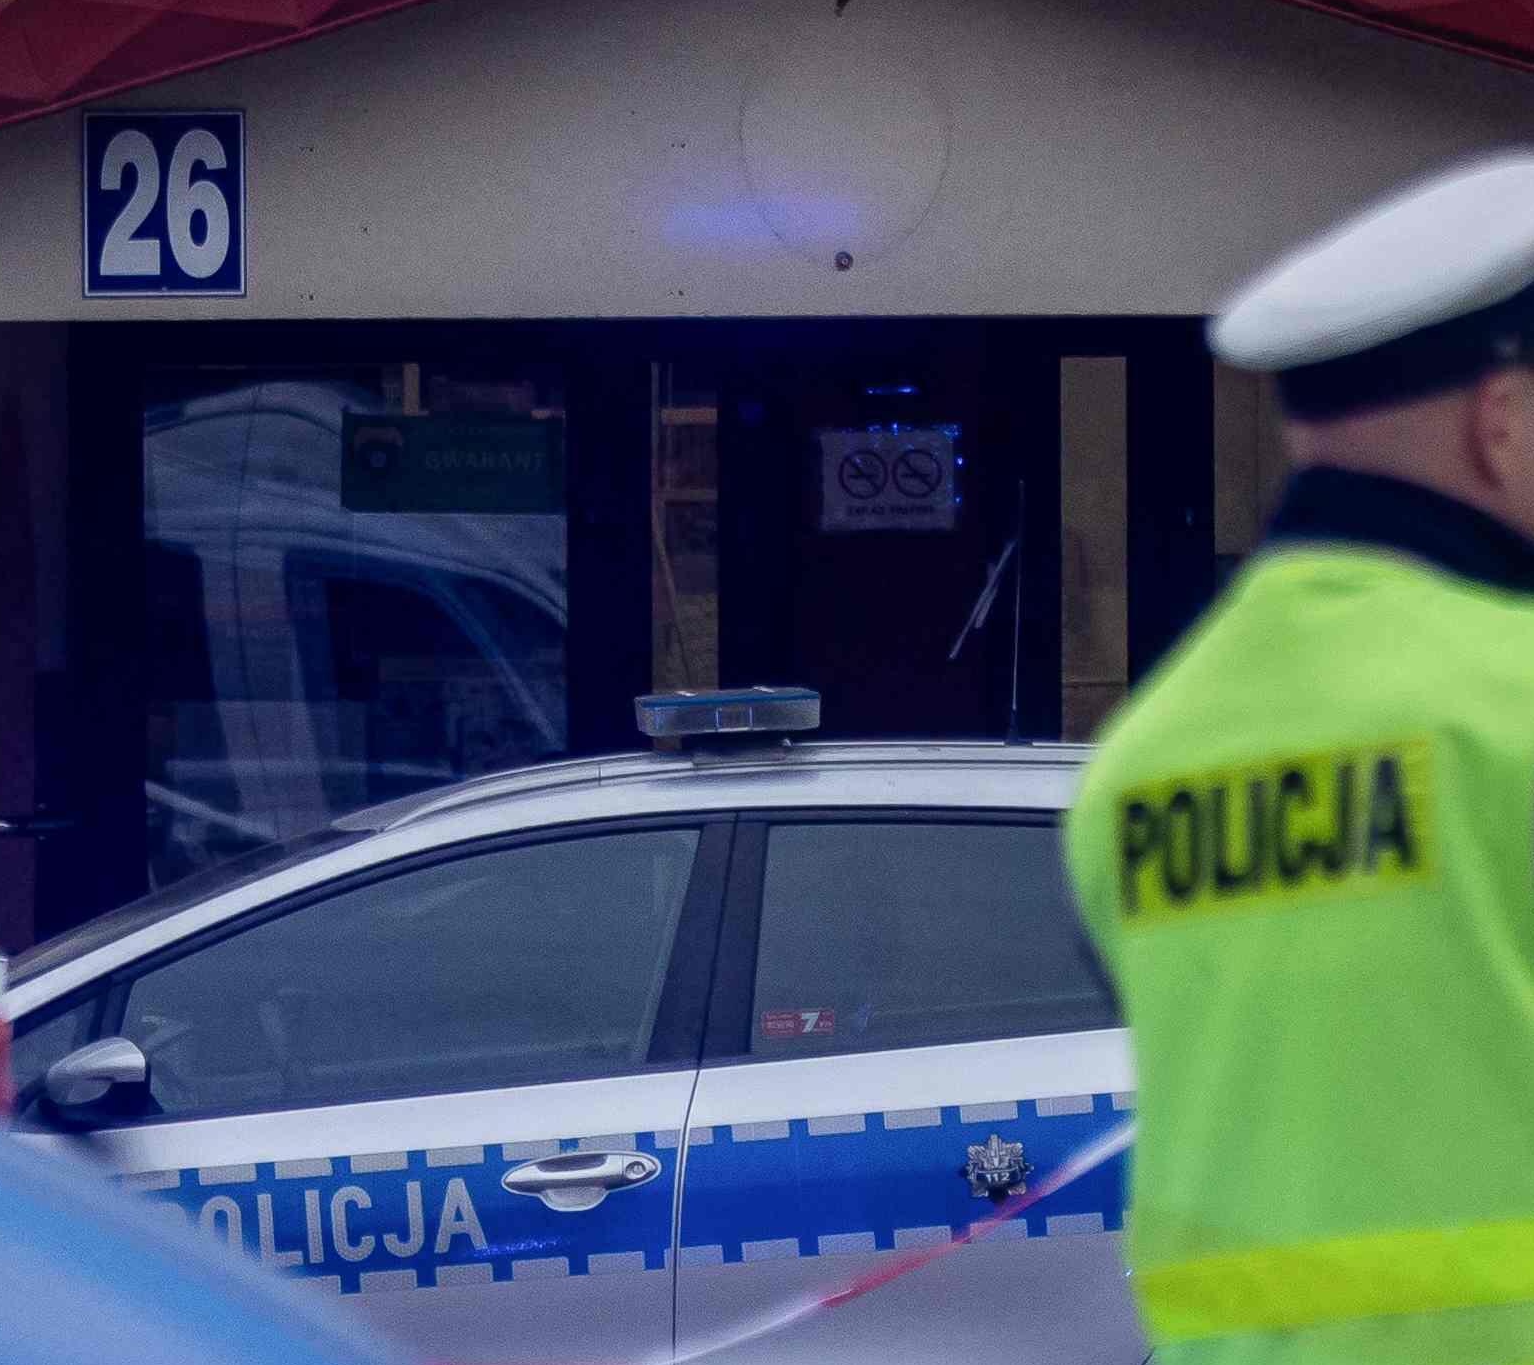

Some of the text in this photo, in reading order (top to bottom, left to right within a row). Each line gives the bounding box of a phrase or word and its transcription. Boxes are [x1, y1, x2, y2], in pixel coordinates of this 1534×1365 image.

[99, 128, 231, 279] 26
[1121, 753, 1420, 918] POLICJA
[985, 1172, 1011, 1183] 112
